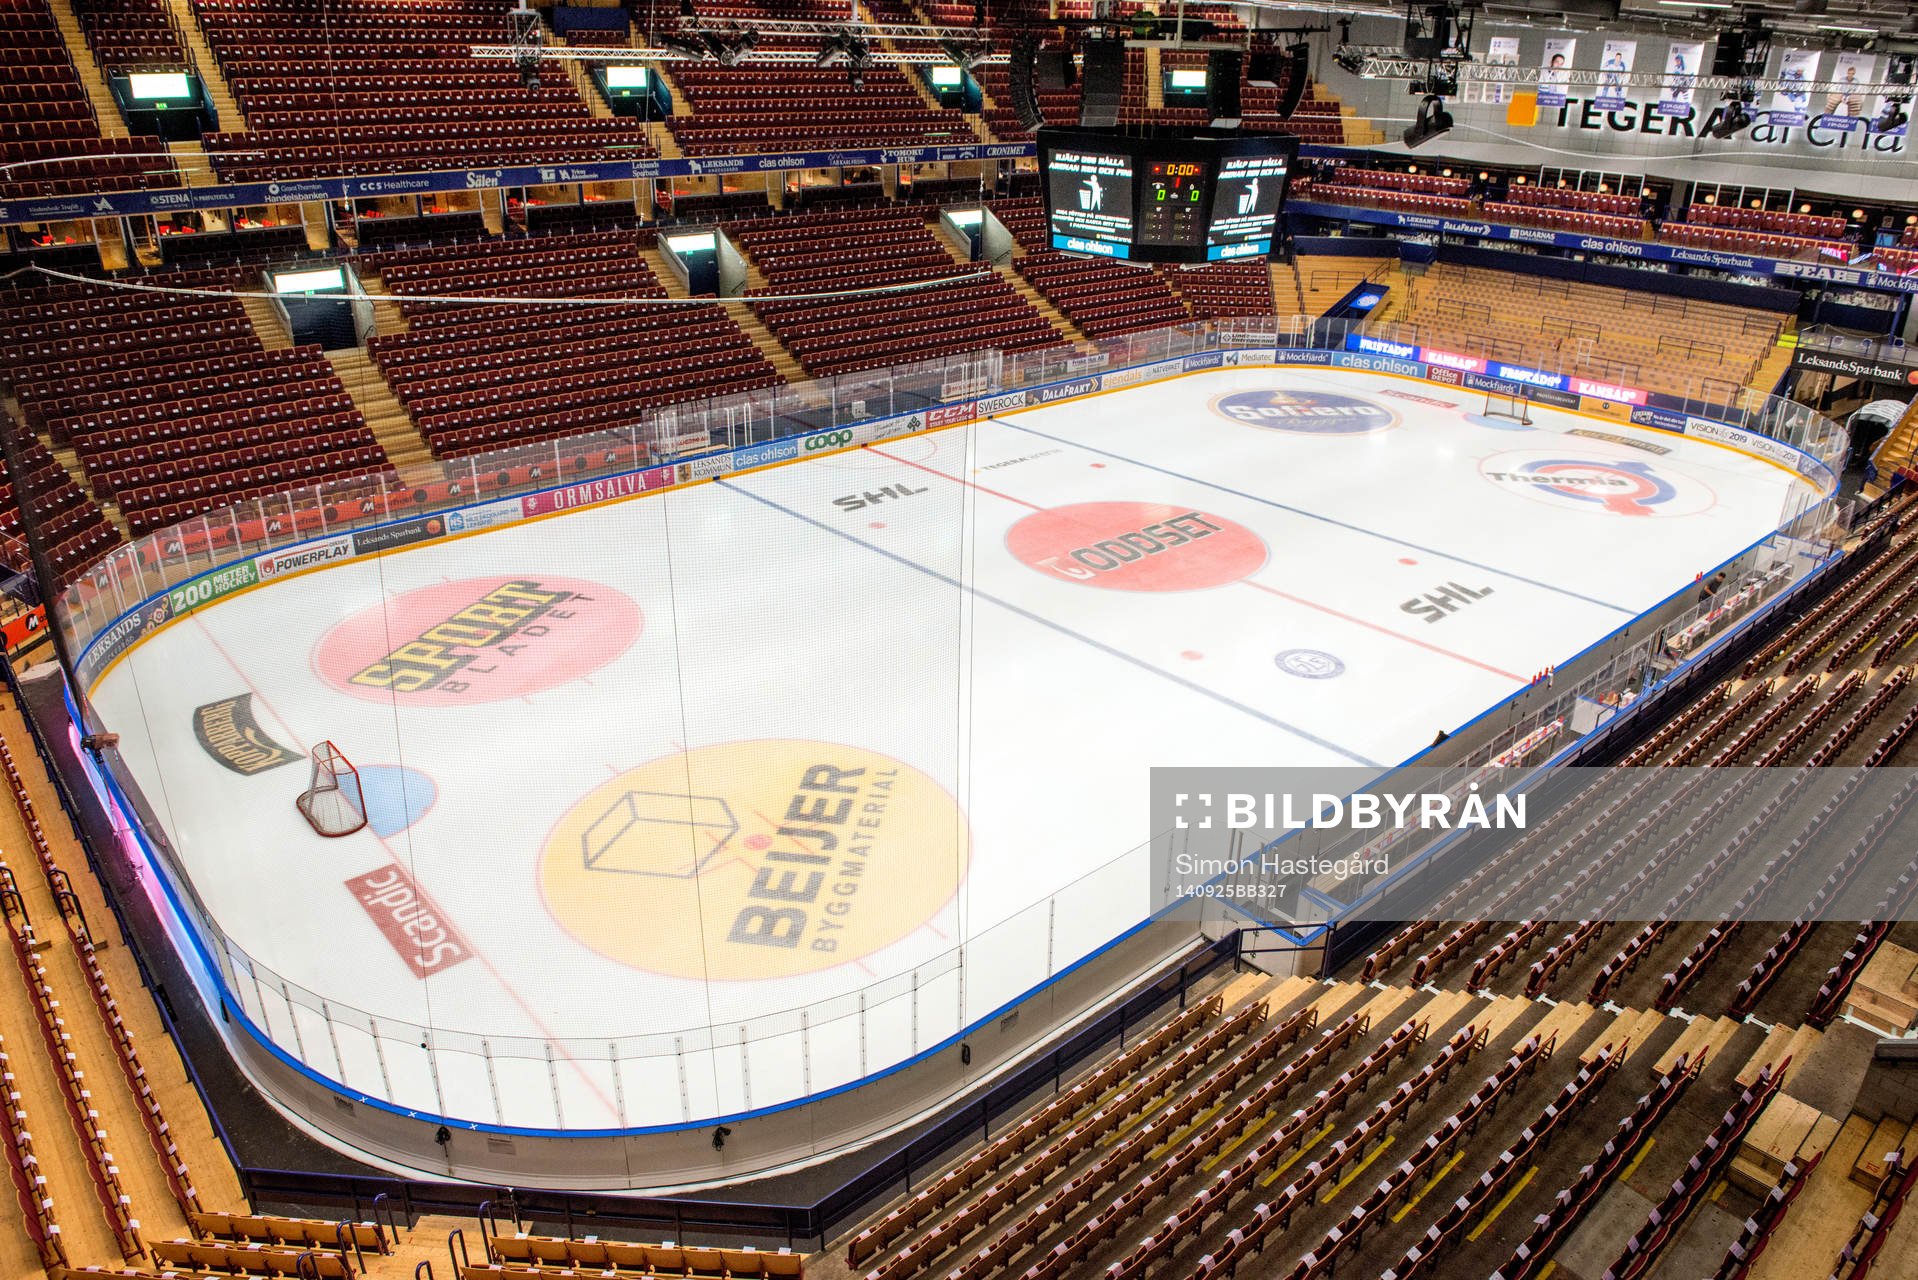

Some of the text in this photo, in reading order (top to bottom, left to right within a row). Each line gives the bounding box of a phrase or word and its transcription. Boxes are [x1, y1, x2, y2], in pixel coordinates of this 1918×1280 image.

[1784, 54, 1791, 63] 2
[1556, 98, 1733, 139] TEGERA
[887, 148, 924, 157] TOMOKU
[986, 145, 1027, 156] CRONIMET
[702, 159, 744, 169] LEKSANDS
[758, 156, 806, 168] clas ohlson
[1055, 153, 1080, 163] HJÄLP
[1098, 156, 1125, 167] HÅLLA
[1166, 163, 1195, 175] 0:00
[281, 183, 322, 192] Grant Thornton
[360, 179, 430, 191] CCS Healthcare
[466, 171, 499, 188] Sälen
[158, 193, 190, 204] STENA
[265, 191, 329, 203] Handelsbanken
[1157, 189, 1166, 201] 0
[1190, 190, 1200, 202] 0
[1406, 215, 1440, 226] LEKSANDS
[1519, 228, 1556, 240] DALARNAS
[1067, 237, 1085, 250] clas
[1085, 240, 1114, 254] ohlson
[1581, 237, 1642, 256] clas ohlson
[1671, 249, 1754, 269] Leksands Sparbank
[1787, 263, 1849, 282] PEAB
[1877, 276, 1918, 292] Mockfjä
[1241, 353, 1273, 362] Mediatec
[1286, 352, 1327, 363] Mockfjärds
[1341, 354, 1418, 376] clas ohlson
[1431, 367, 1458, 379] Office
[1797, 352, 1903, 381] Leksands Sparbank
[1103, 370, 1143, 387] ejendals
[1431, 375, 1457, 384] DEPOT
[1474, 378, 1514, 393] Mockfjärds
[1578, 382, 1630, 402] KANSAS
[978, 392, 1024, 413] SWEROCK
[929, 403, 974, 421] CCM
[804, 429, 853, 451] coop
[1690, 422, 1719, 435] VISION
[1729, 431, 1748, 443] 2019
[1751, 437, 1775, 453] VISION
[693, 454, 731, 469] LEKSANDS
[736, 443, 797, 467] clas ohlson
[693, 463, 732, 478] KOMMUN
[1486, 471, 1629, 487] Thermia
[553, 474, 647, 509] ORMSALVA
[832, 483, 928, 512] SHL
[390, 526, 422, 540] Sparbank
[1071, 511, 1224, 571] ODDSET
[276, 543, 350, 573] POWERPLAY
[213, 565, 250, 585] METER
[215, 572, 256, 595] HOCKEY
[173, 579, 213, 613] 200
[1400, 581, 1495, 624] SHL
[87, 612, 142, 668] LEKSANDS
[347, 580, 573, 692] SPORT
[438, 592, 595, 694] BLADET
[726, 763, 866, 949] BEIJER
[810, 768, 898, 953] BYGGMATERIAL
[363, 870, 462, 968] Scandic
